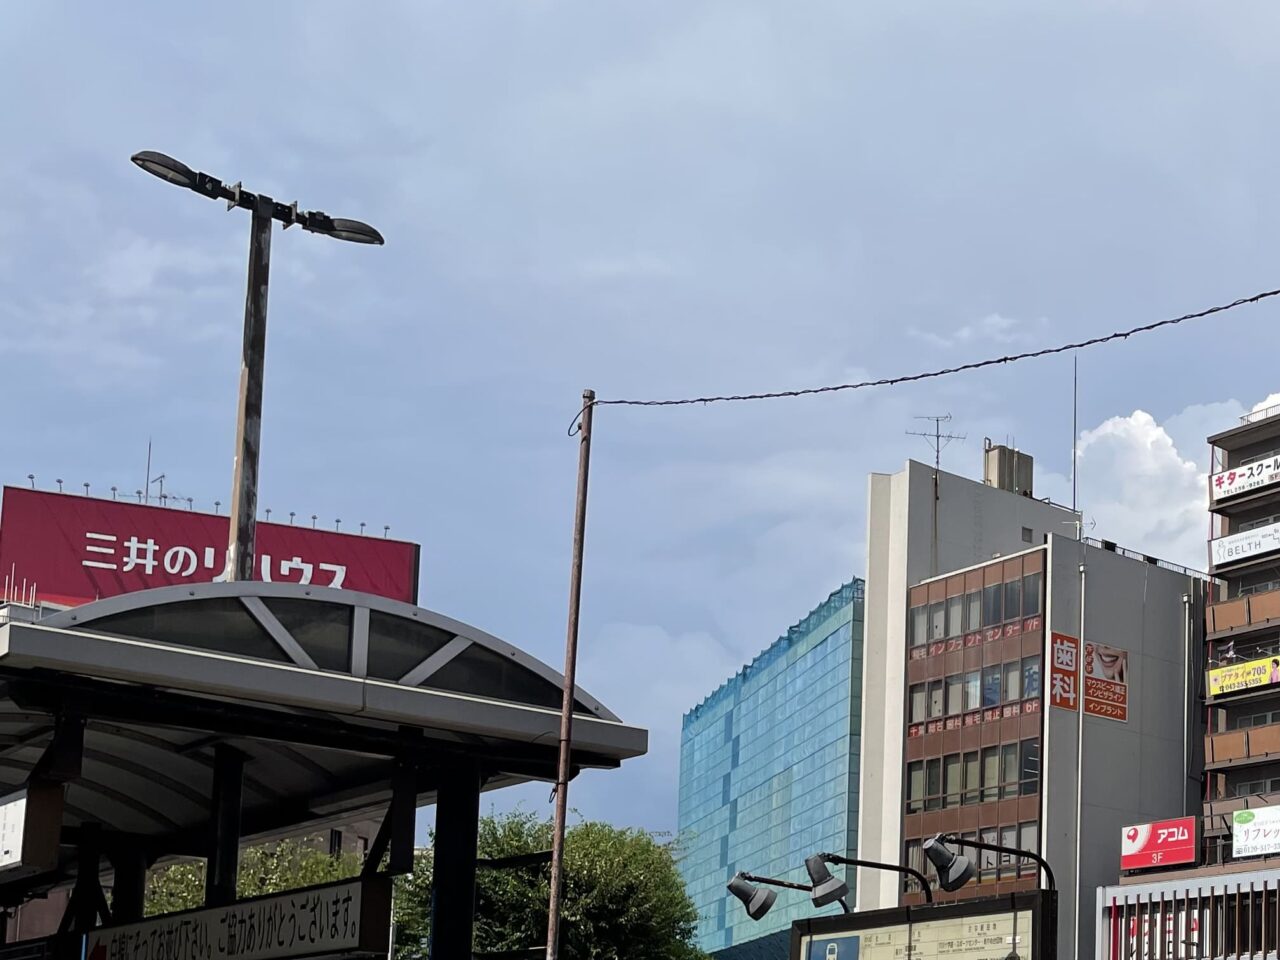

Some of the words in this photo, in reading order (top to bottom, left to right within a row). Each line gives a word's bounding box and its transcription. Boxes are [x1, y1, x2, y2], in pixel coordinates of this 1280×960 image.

[1215, 458, 1280, 489] ギタースクール
[1227, 540, 1261, 556] BELTH
[1052, 639, 1077, 706] 歯科
[1088, 688, 1123, 702] インビザライン
[1089, 703, 1123, 715] インプラント
[1157, 827, 1188, 843] アコム
[1152, 852, 1164, 863] 3F
[218, 893, 357, 957] ご協力ありがとうございます。
